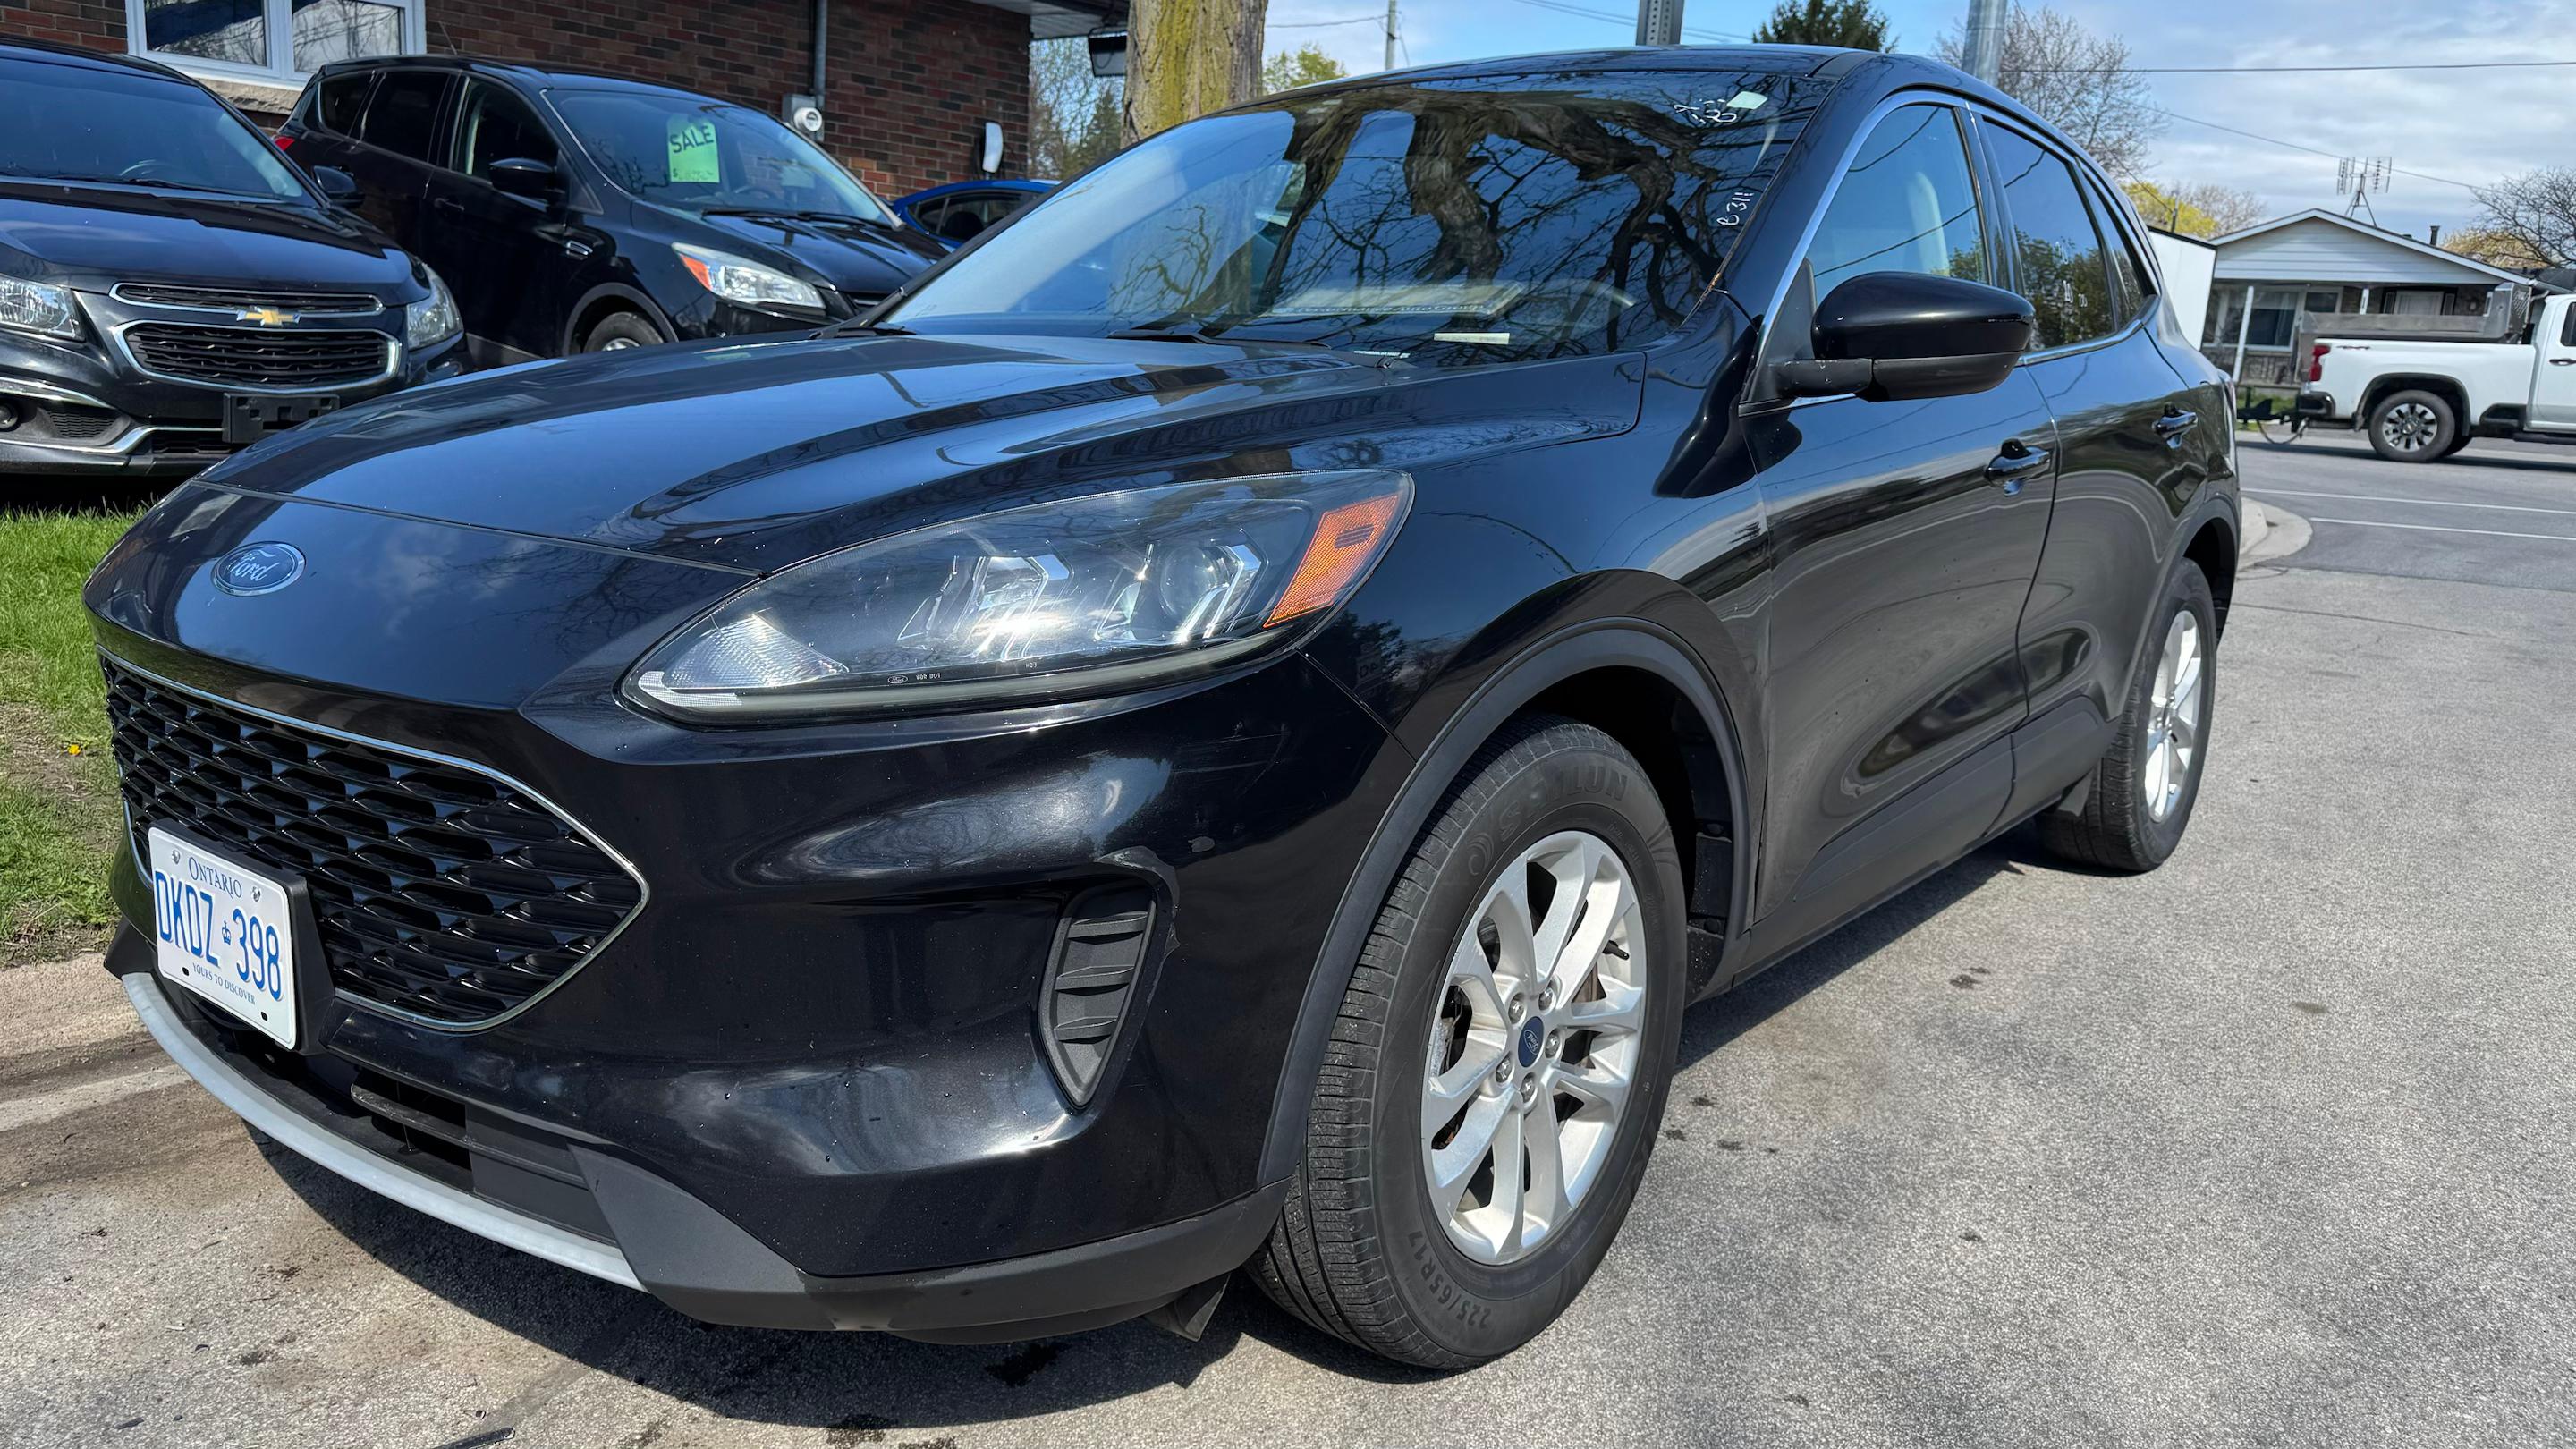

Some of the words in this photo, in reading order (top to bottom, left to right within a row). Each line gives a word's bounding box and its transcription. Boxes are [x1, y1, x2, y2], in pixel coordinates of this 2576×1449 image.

[669, 125, 714, 153] SALE
[227, 548, 280, 581] Ford
[188, 856, 242, 899] ONTARIO
[155, 870, 220, 968] DKDZ
[233, 908, 283, 1002] 398
[192, 962, 213, 982] YOURS
[214, 976, 224, 987] TO
[225, 980, 256, 1006] DISCOVER
[1408, 1231, 1492, 1329] 225/65R17
